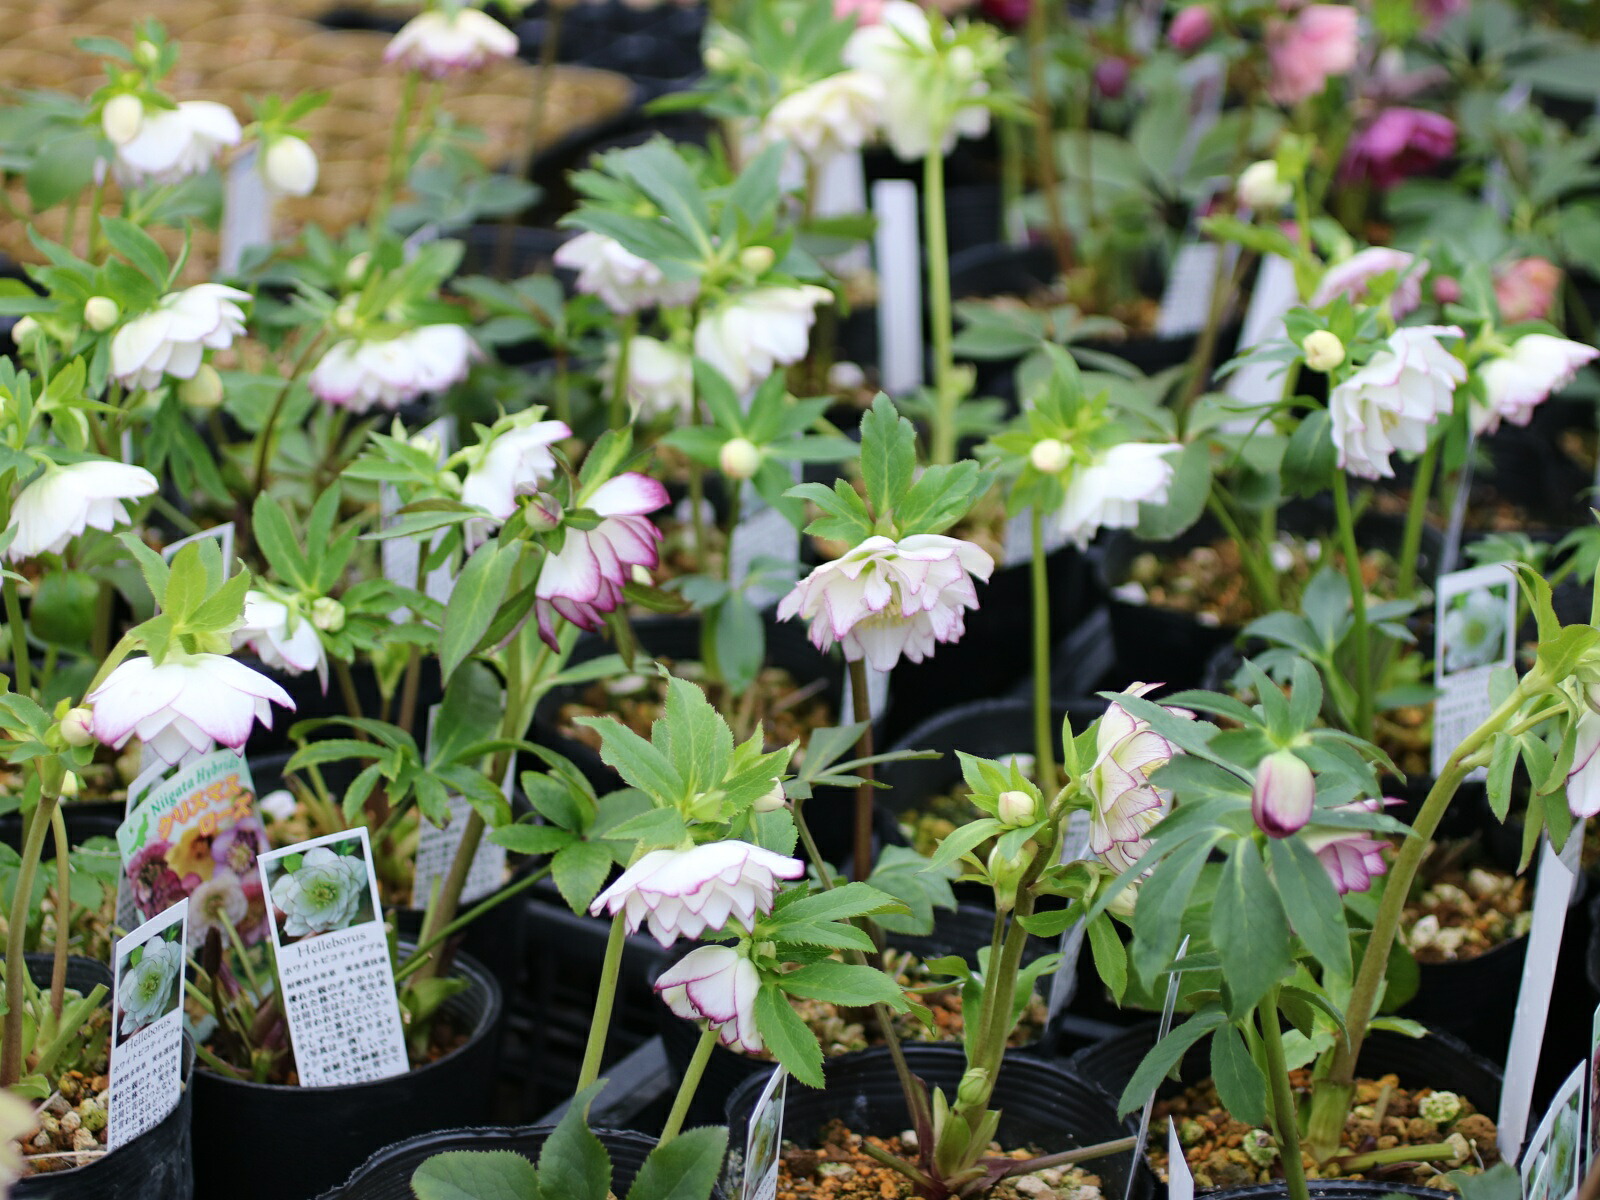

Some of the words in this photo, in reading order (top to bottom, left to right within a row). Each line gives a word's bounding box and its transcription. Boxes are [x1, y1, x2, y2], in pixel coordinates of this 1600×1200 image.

[151, 778, 195, 815] Niigata
[197, 759, 240, 785] Hybrids
[158, 773, 243, 841] クリスマス
[297, 932, 367, 958] Helleborus
[125, 1020, 171, 1053] Helleborus
